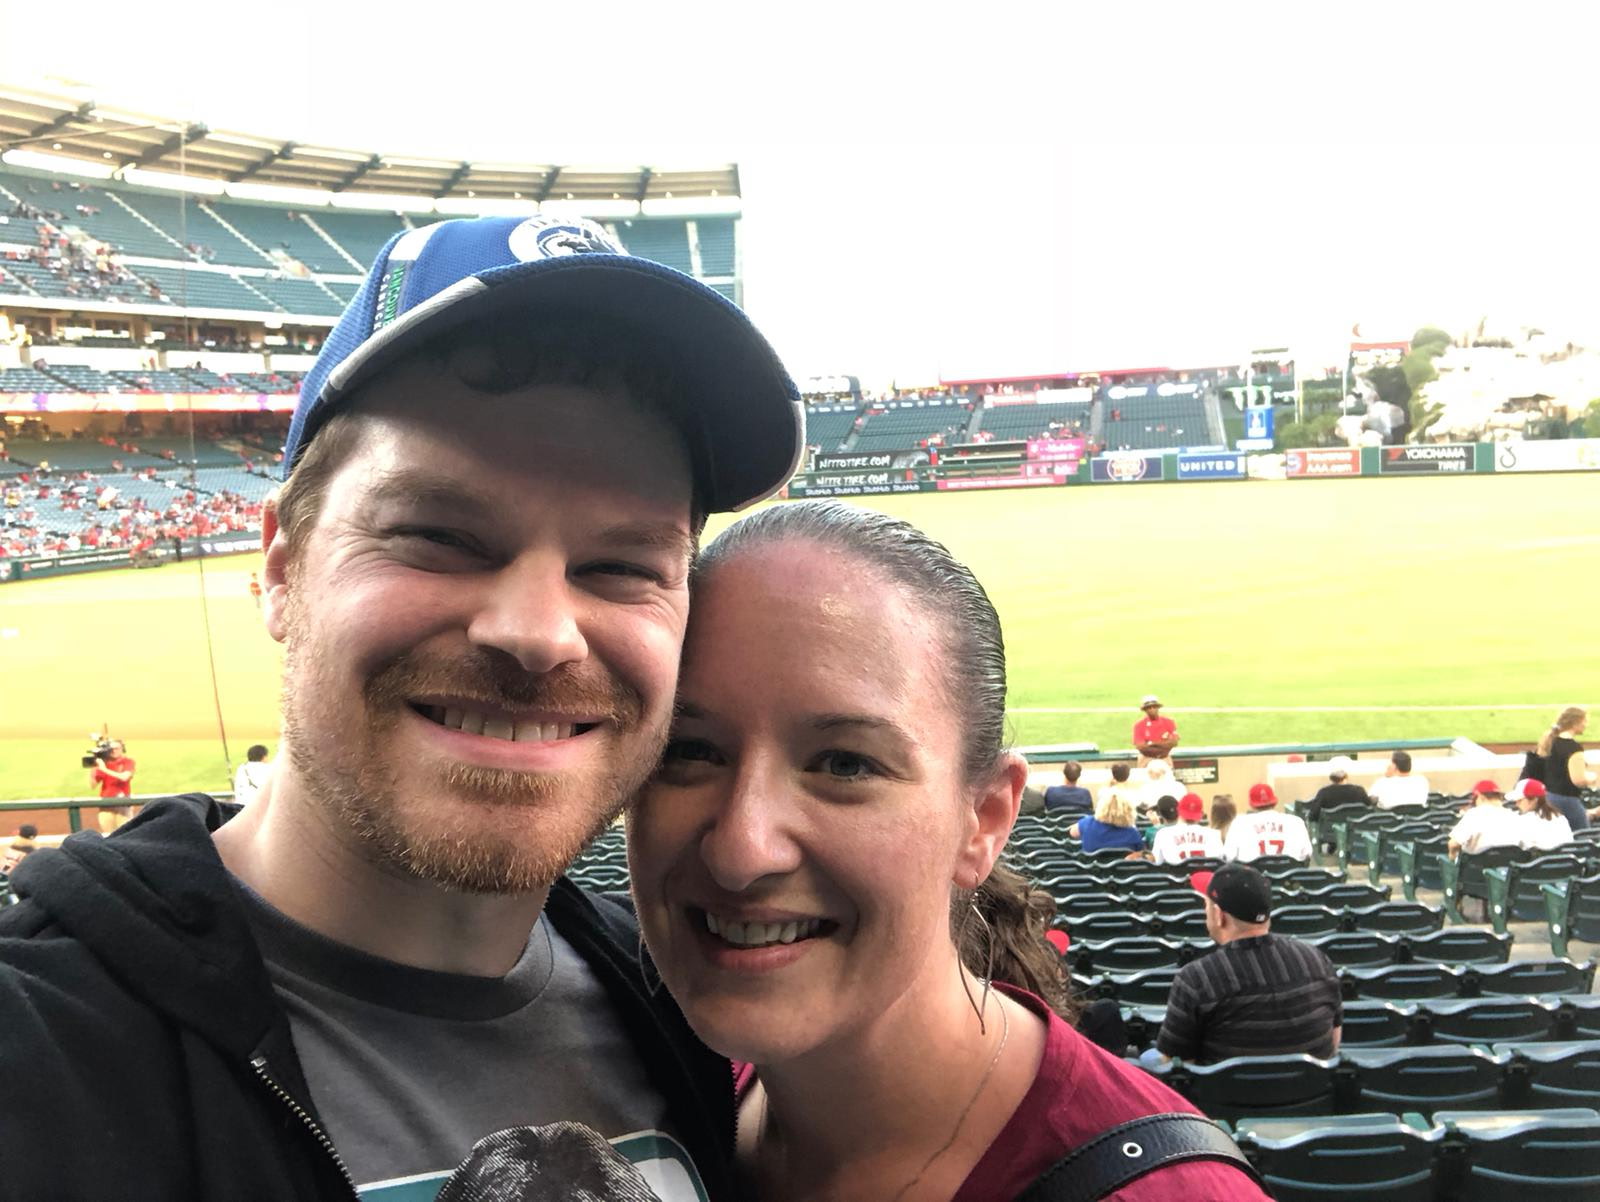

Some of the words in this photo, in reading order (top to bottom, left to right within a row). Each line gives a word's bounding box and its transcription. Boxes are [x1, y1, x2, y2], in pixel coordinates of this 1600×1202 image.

[1406, 447, 1467, 459] YOKOHAMA
[1180, 461, 1235, 472] UNITED
[1253, 821, 1286, 834] OHTAN
[1258, 839, 1286, 857] 17
